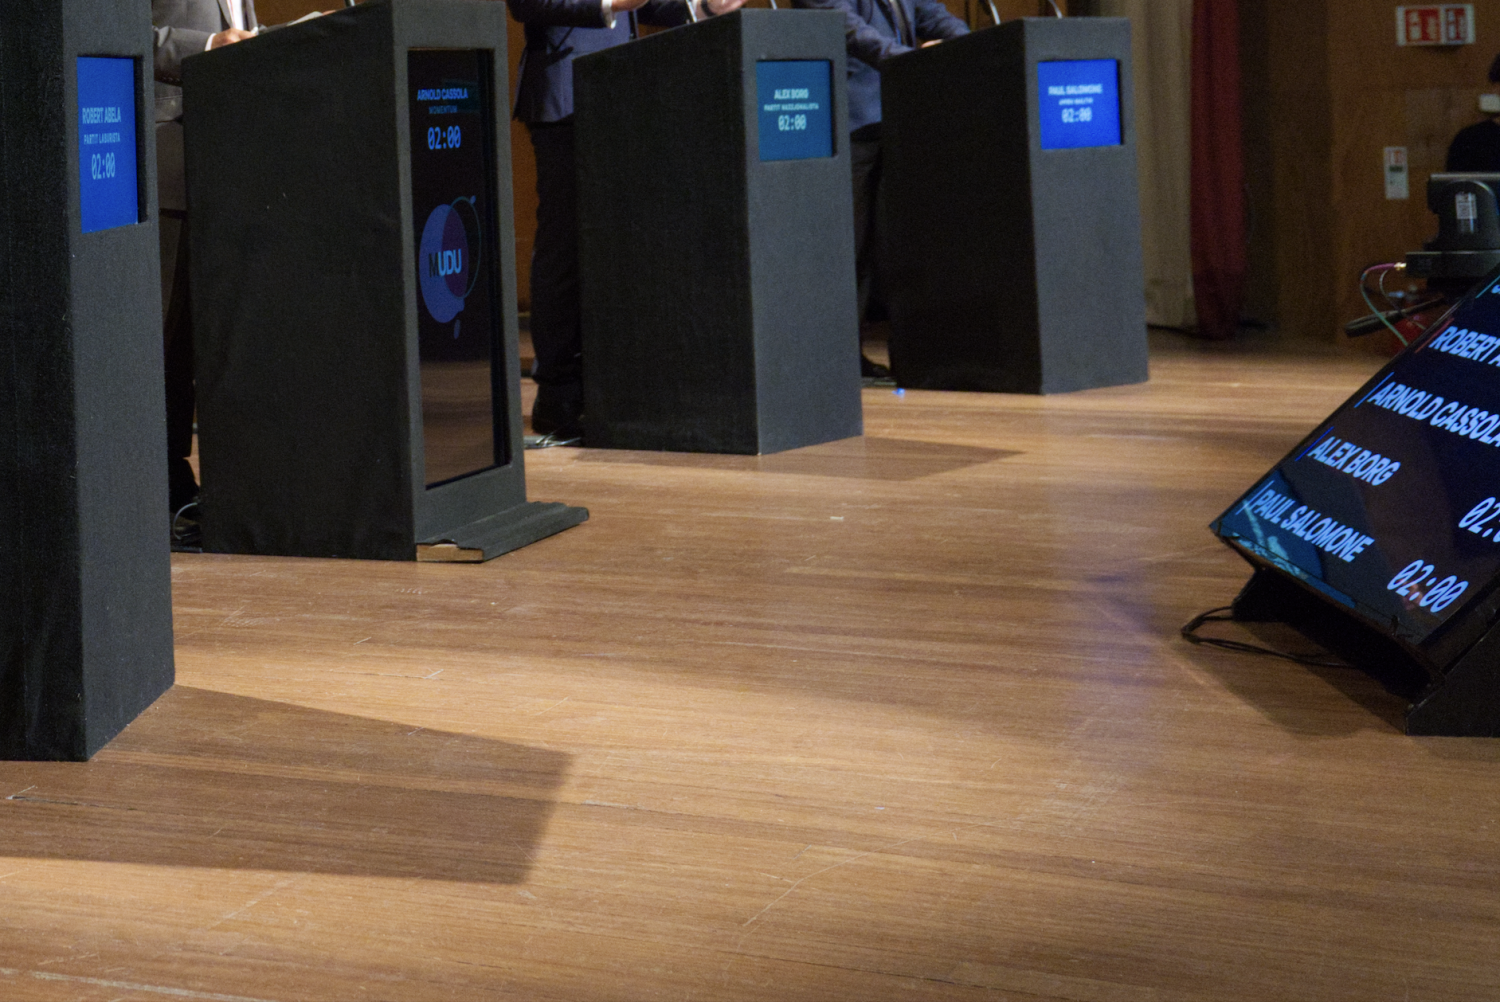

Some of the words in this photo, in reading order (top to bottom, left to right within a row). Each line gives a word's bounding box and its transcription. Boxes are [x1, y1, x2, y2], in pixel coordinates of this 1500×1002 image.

[417, 89, 441, 101] ARNOLD
[442, 87, 468, 100] CASSOLA
[774, 89, 790, 99] ALEX
[82, 107, 103, 124] ROBERT
[104, 106, 122, 123] ABELA
[778, 114, 807, 131] 02:00
[1062, 106, 1092, 123] 02:00
[84, 134, 98, 145] PARTIT
[99, 132, 120, 144] LABURISTA
[427, 125, 461, 150] 02:00
[91, 152, 116, 180] 02:00
[429, 248, 462, 278] MUDU
[1429, 326, 1500, 363] ROBERT
[1367, 381, 1445, 421] ARNOLD
[1307, 436, 1362, 471] ALEX
[1342, 450, 1401, 486] BORG
[1252, 489, 1295, 524] PAUL
[1280, 505, 1375, 563] SALOMONE
[1387, 559, 1469, 613] 02:00
